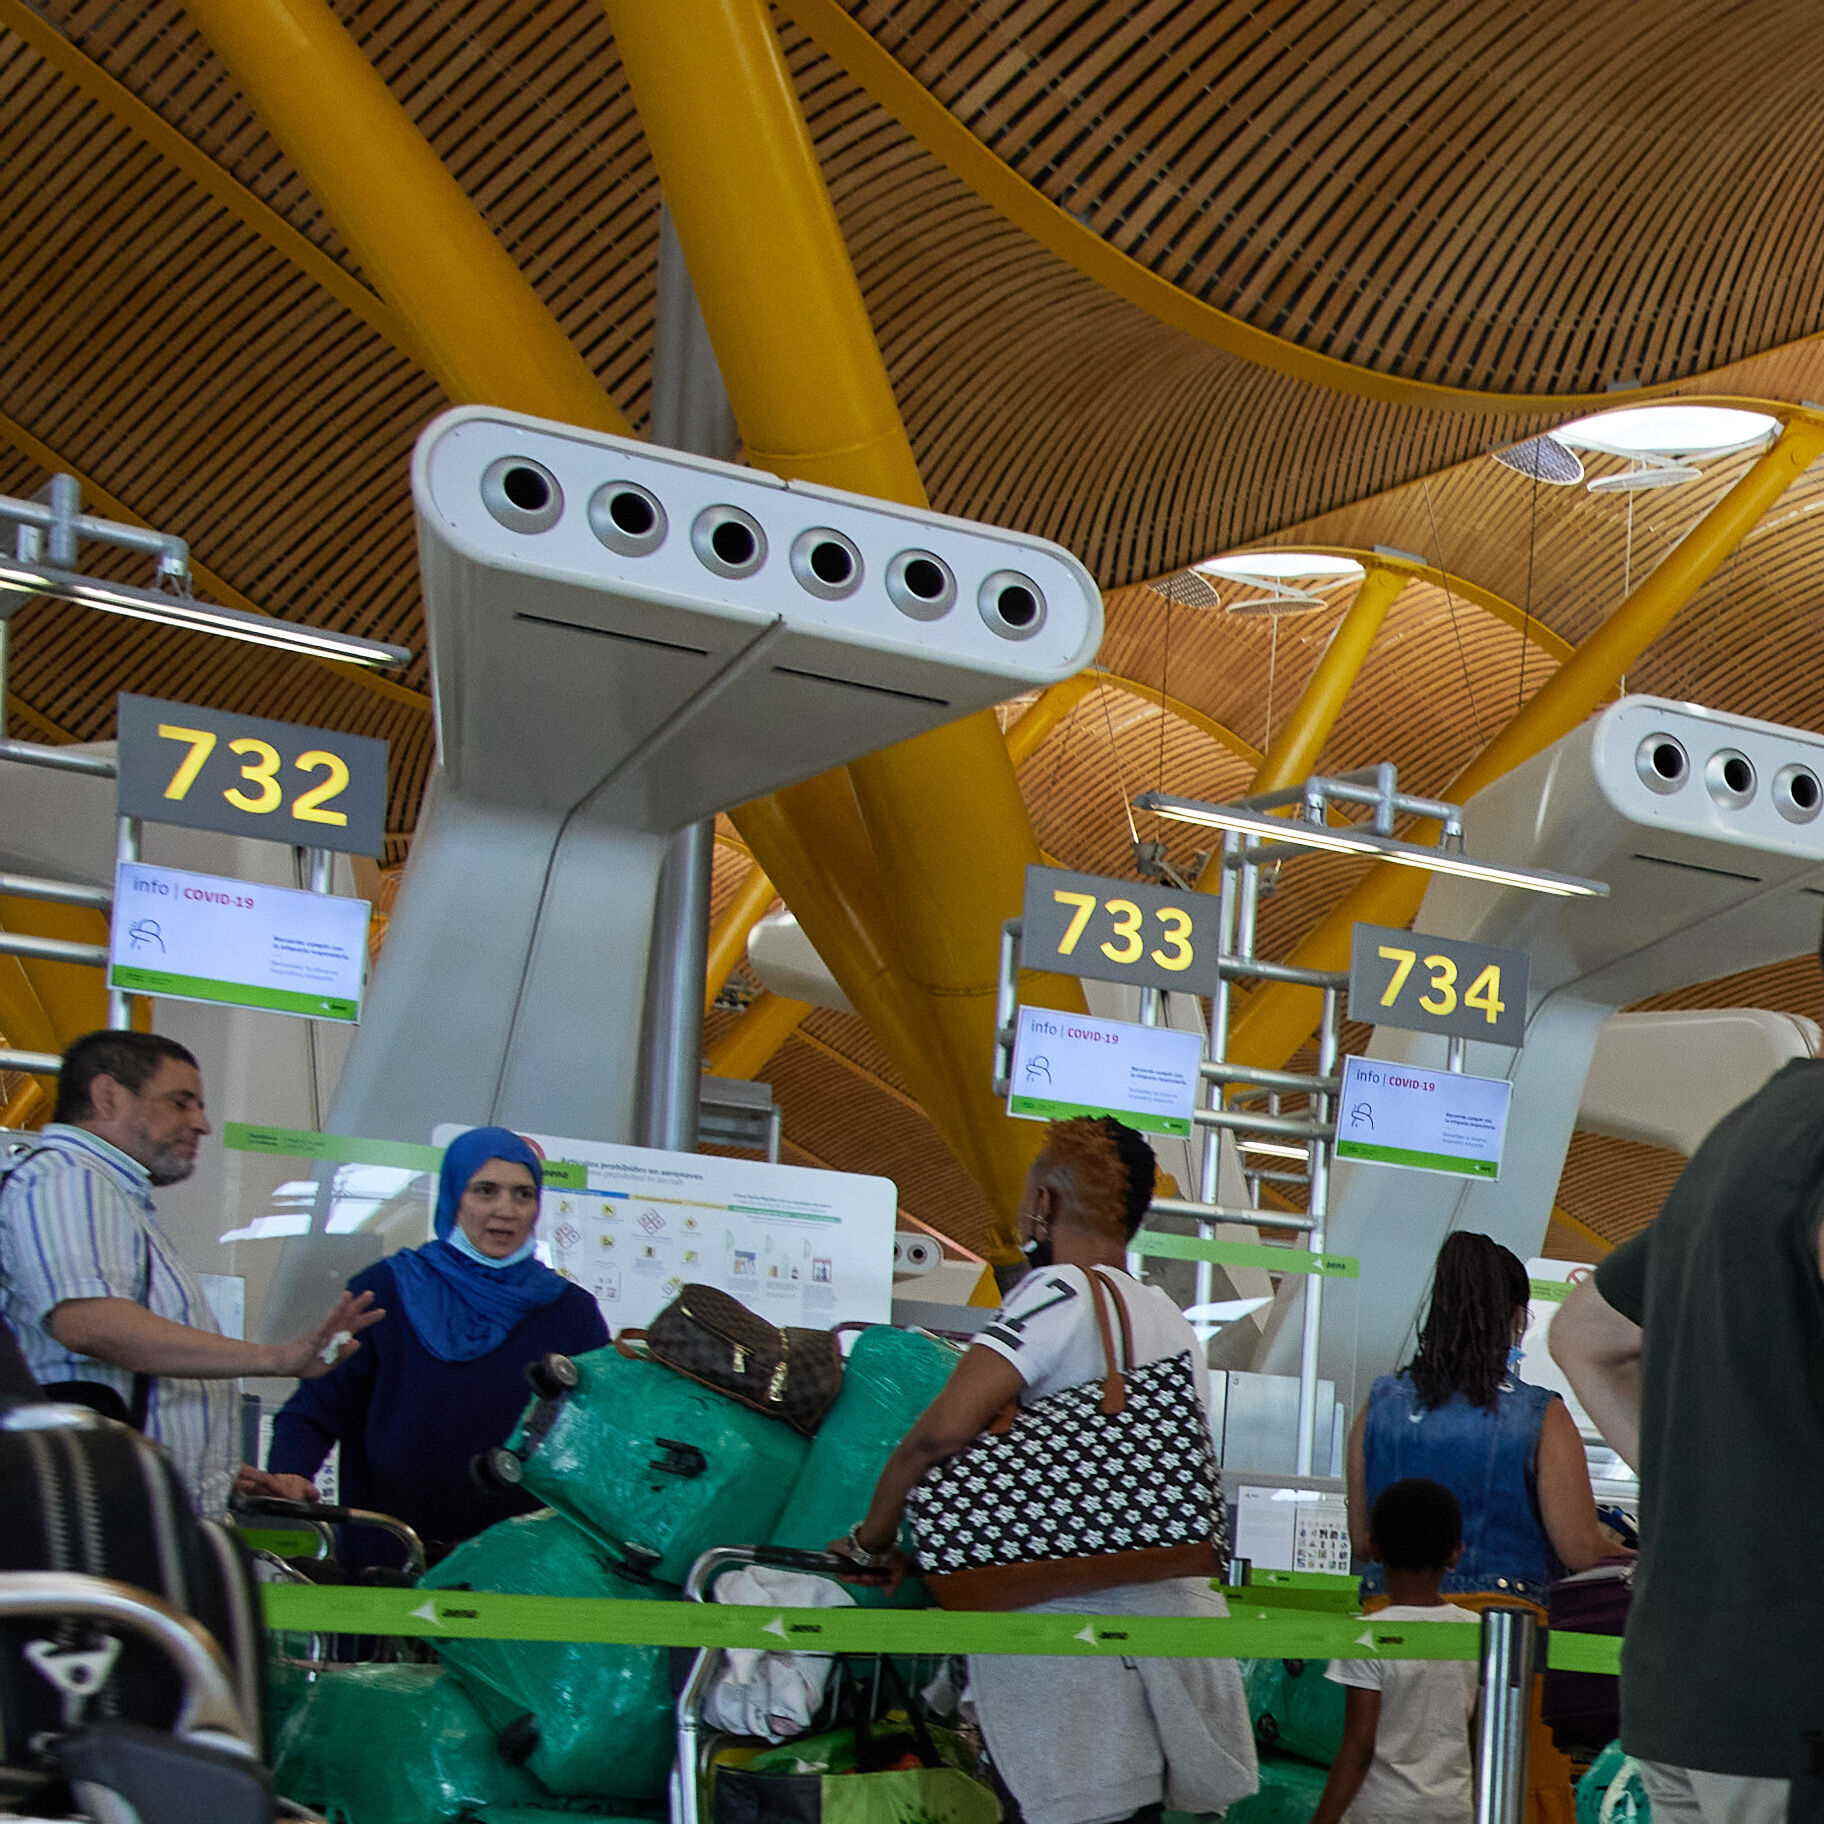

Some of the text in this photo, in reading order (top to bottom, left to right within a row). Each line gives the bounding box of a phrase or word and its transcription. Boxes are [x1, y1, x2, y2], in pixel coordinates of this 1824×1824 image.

[157, 724, 350, 826] 732
[133, 876, 255, 909] info COVID-19
[1053, 891, 1194, 971] 733
[1379, 946, 1505, 1023] 734
[1031, 1019, 1119, 1044] info COVID-19
[1356, 1069, 1435, 1092] info COVID-19
